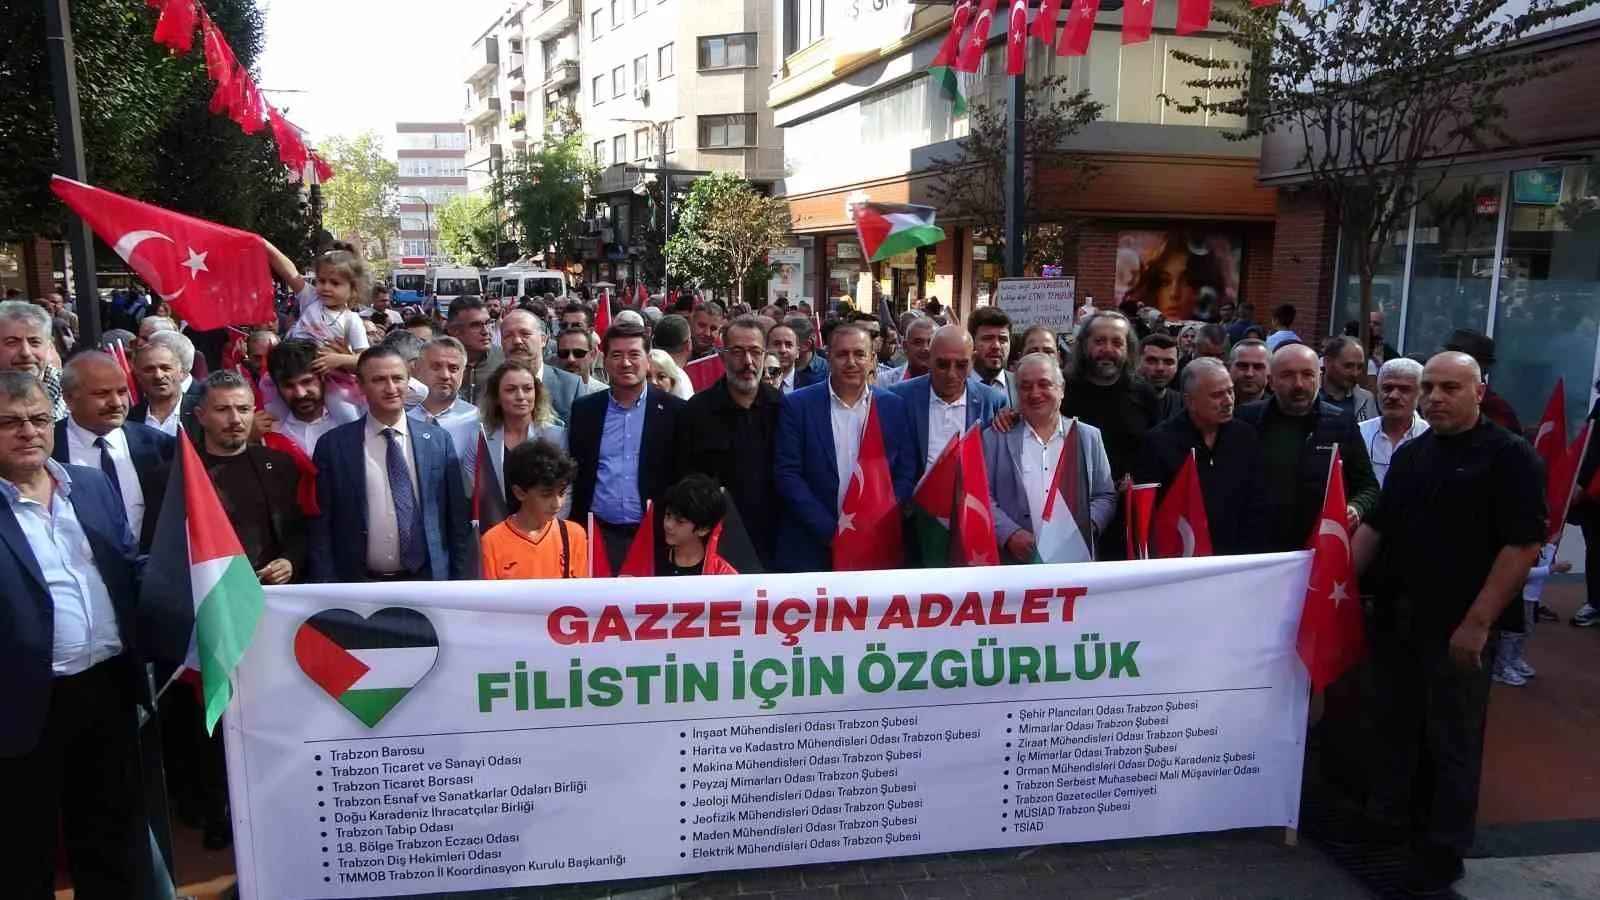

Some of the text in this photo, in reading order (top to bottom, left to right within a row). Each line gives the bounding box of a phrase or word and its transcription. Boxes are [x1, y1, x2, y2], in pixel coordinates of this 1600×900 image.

[546, 586, 1087, 645] GAZZE İÇİN ADALET
[477, 633, 1141, 713] FİLİSTİN İÇİN ÖZGÜRLÜK
[1019, 700, 1198, 721] Şehir Plancıları Odası Trabzon Şubesi
[730, 723, 801, 737] Mühendisleri
[804, 721, 835, 732] Odası
[838, 719, 879, 730] Trabzon
[882, 716, 918, 728] Şubesi
[1019, 716, 1168, 734] Mimarlar Odası Trabzon Şubesi
[693, 745, 727, 755] Harita
[745, 741, 794, 752] Kadastro
[797, 736, 867, 749] Mühendisleri
[870, 735, 900, 745] Odası
[903, 732, 942, 742] Trabzon
[945, 729, 980, 741] Şubesi
[1018, 726, 1218, 748] Ziraat Mühendisleri Odası Trabzon Şubesi
[330, 746, 424, 760] Trabzon Barosu
[735, 757, 806, 770] Mühendisleri
[809, 755, 840, 765] Odası
[843, 752, 883, 763] Trabzon
[886, 750, 922, 762] Şubesi
[1028, 748, 1072, 760] Mimarlar
[1074, 747, 1102, 758] Odası
[1105, 745, 1142, 756] Trabzon
[1145, 743, 1177, 755] Şubesi
[331, 765, 379, 777] Trabzon
[383, 762, 424, 773] Ticaret
[446, 758, 485, 770] Sanayi
[488, 755, 521, 766] Odası
[1016, 751, 1255, 776] Orman Mühendisleri Odası Doğu Karadeniz Şubesi
[332, 775, 473, 792] Trabzon Ticaret Borsası
[693, 768, 897, 791] Peyzaj Mimarları Odası Trabzon Şubesi
[1016, 779, 1054, 790] Trabzon
[1057, 776, 1095, 787] Serbest
[1233, 765, 1260, 775] Odası
[334, 796, 380, 808] Trabzon
[384, 794, 418, 804] Esnaf
[439, 788, 507, 801] Sanatkarlar
[511, 785, 552, 796] Odaları
[555, 781, 587, 794] Birliği
[692, 783, 916, 809] Jeoloji Mühendisleri Odası Trabzon Şubesi
[1015, 784, 1156, 804] Trabzon Gazeteciler Cemiyeti
[335, 812, 366, 824] Doğu
[370, 808, 428, 821] Karadeniz
[502, 802, 534, 814] Birliği
[692, 799, 922, 825] Jeofizik Mühendisleri Odası Trabzon Şubesi
[1057, 804, 1095, 816] Trabzon
[1097, 801, 1130, 814] Şubesi
[336, 822, 454, 838] Trabzon Tabip Odası
[692, 816, 917, 842] Maden Mühendisleri Odası Trabzon Şubesi
[337, 833, 519, 853] 18. Bölge Trabzon Eczacı Odası
[692, 833, 921, 858] Elektrik Mühendisleri Odası Trabzon Şubesi
[338, 849, 502, 868] Trabzon Diş Hekimleri Odası
[339, 871, 385, 884] TMMOB
[389, 868, 435, 880] Trabzon
[446, 863, 525, 876] Koordinasyon
[529, 859, 565, 870] Kurulu
